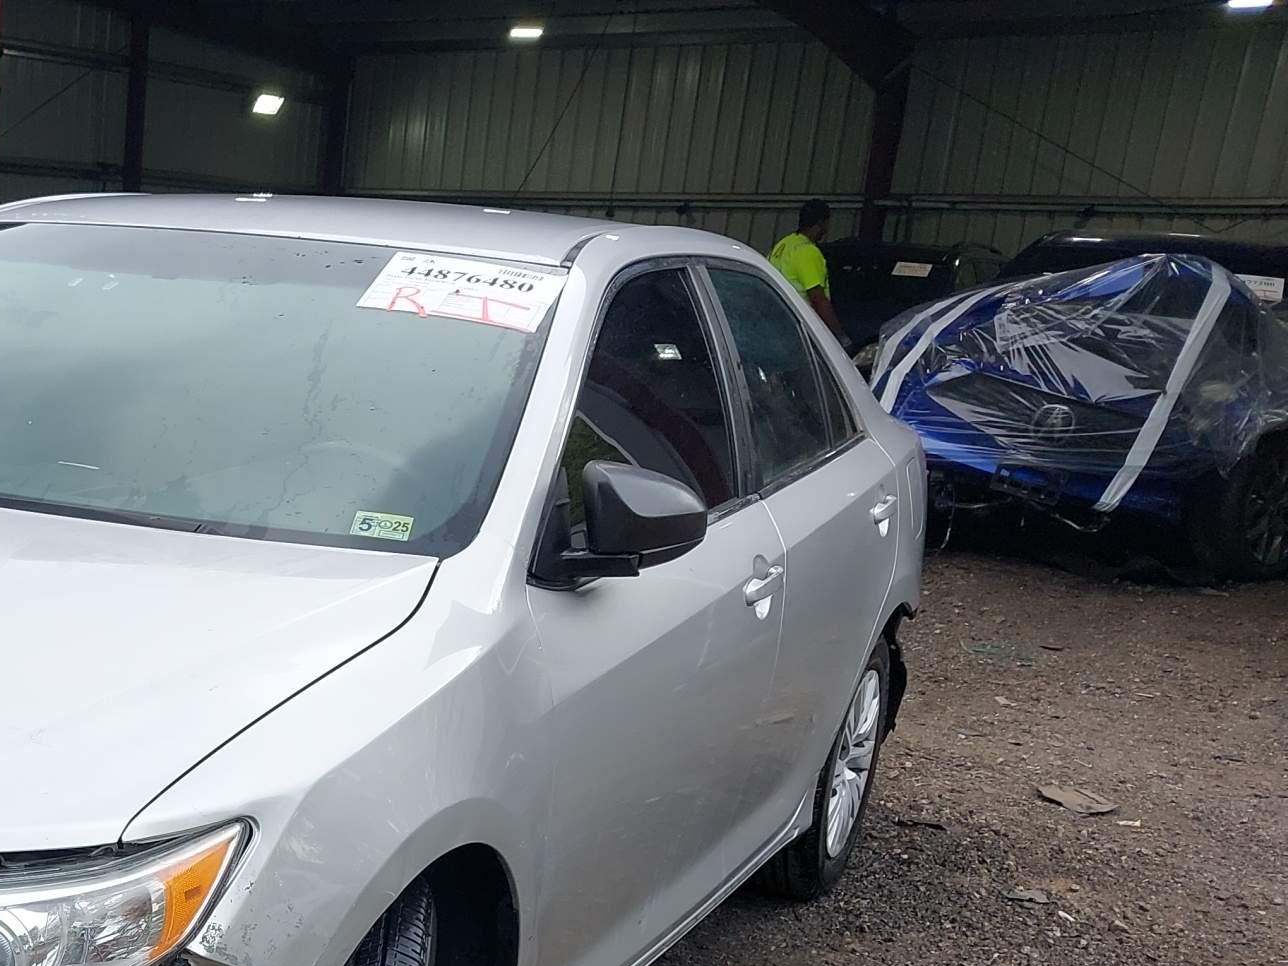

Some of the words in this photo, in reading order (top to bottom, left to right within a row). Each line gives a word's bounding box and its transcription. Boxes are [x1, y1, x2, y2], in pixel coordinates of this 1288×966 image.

[401, 265, 534, 293] 44876480
[358, 518, 374, 532] 5
[392, 520, 410, 533] 25
